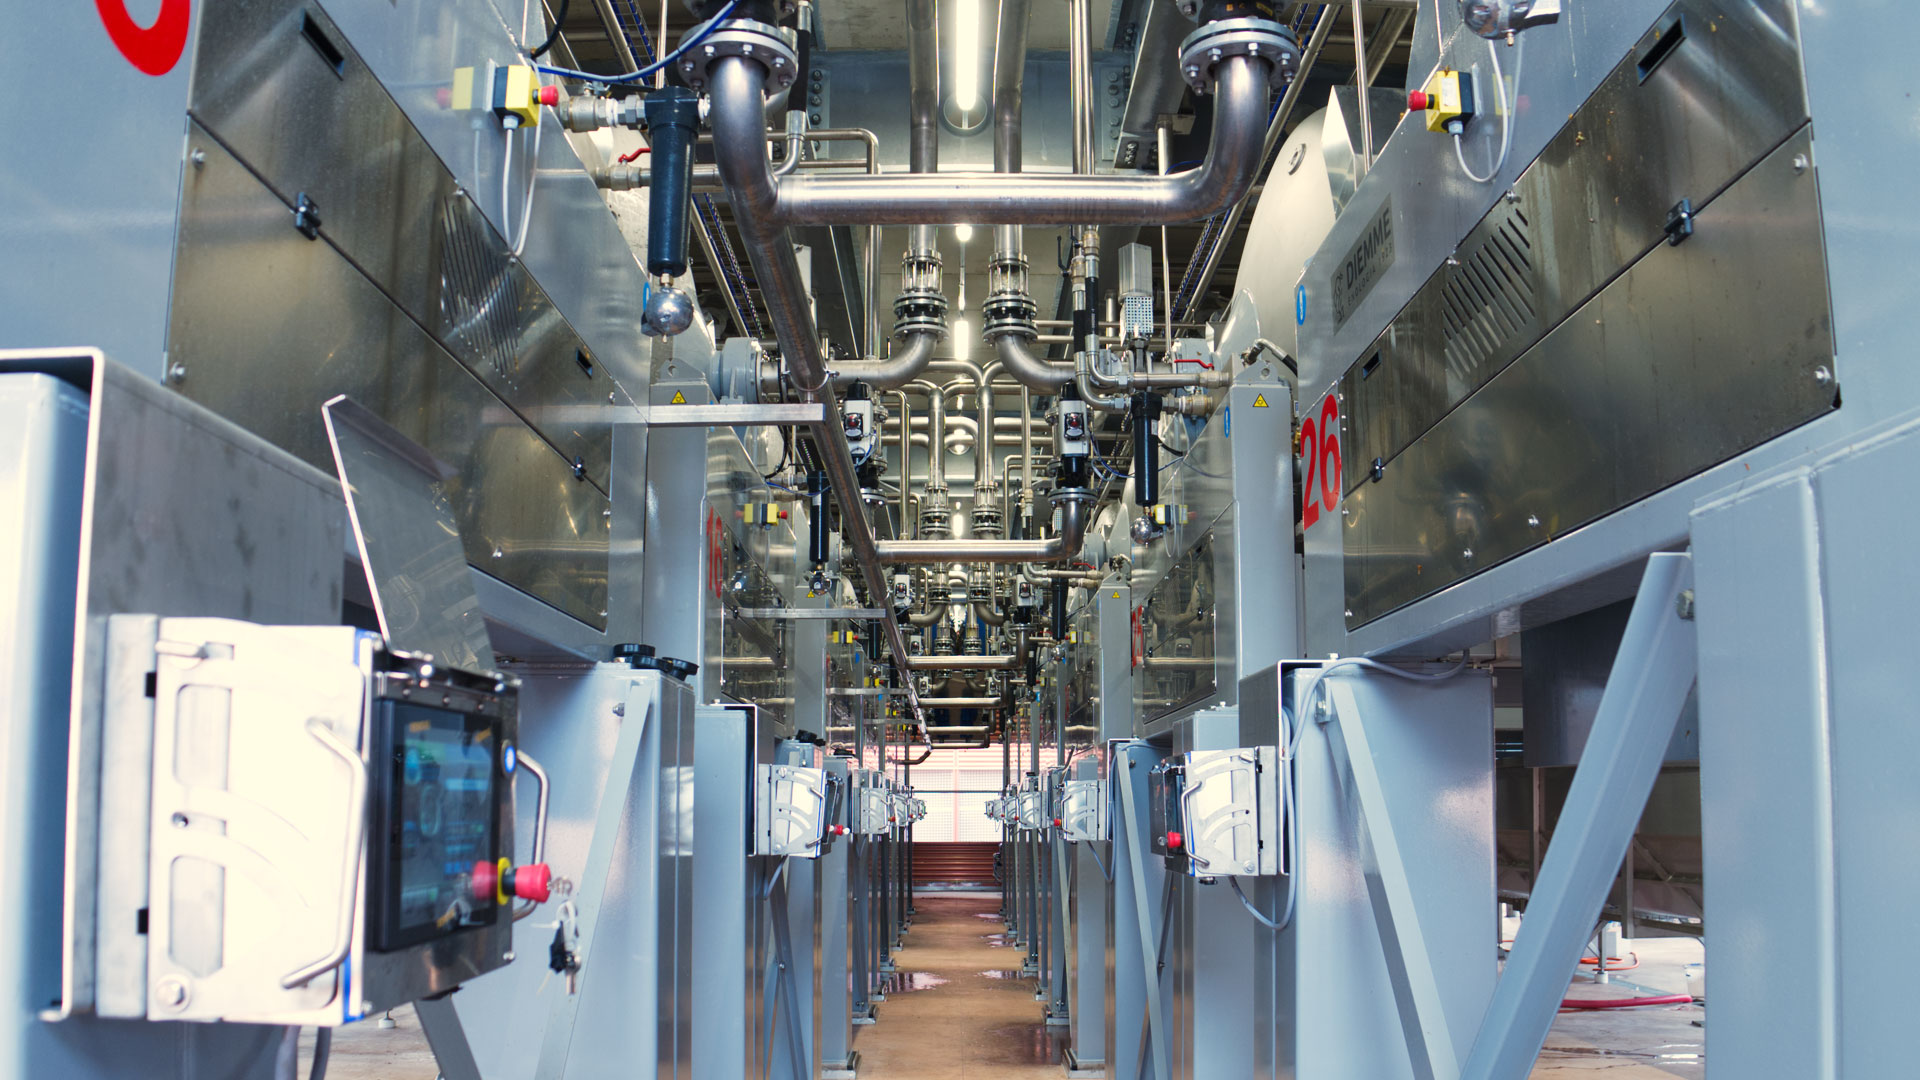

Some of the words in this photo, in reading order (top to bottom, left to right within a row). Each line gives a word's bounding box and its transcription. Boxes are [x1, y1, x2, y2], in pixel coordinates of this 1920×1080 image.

[1346, 207, 1391, 290] DIEMME
[1300, 394, 1342, 530] 26
[706, 506, 723, 599] 16
